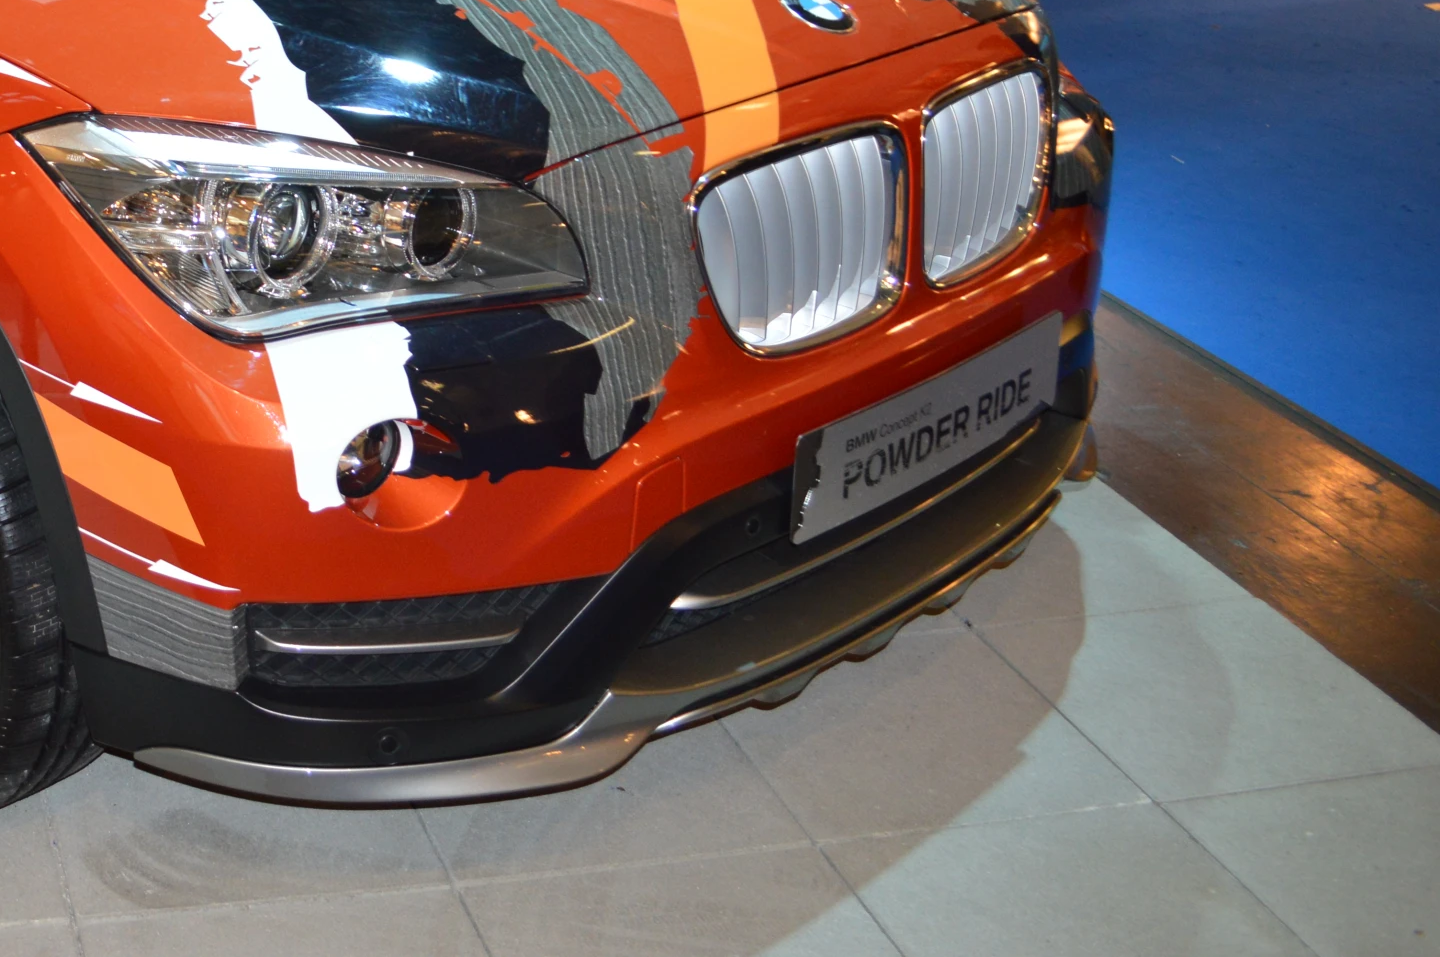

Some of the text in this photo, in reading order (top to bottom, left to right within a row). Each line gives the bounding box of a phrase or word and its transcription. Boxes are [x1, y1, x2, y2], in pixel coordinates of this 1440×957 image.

[843, 368, 1033, 499] POWDER RIDE
[845, 428, 878, 453] BMW
